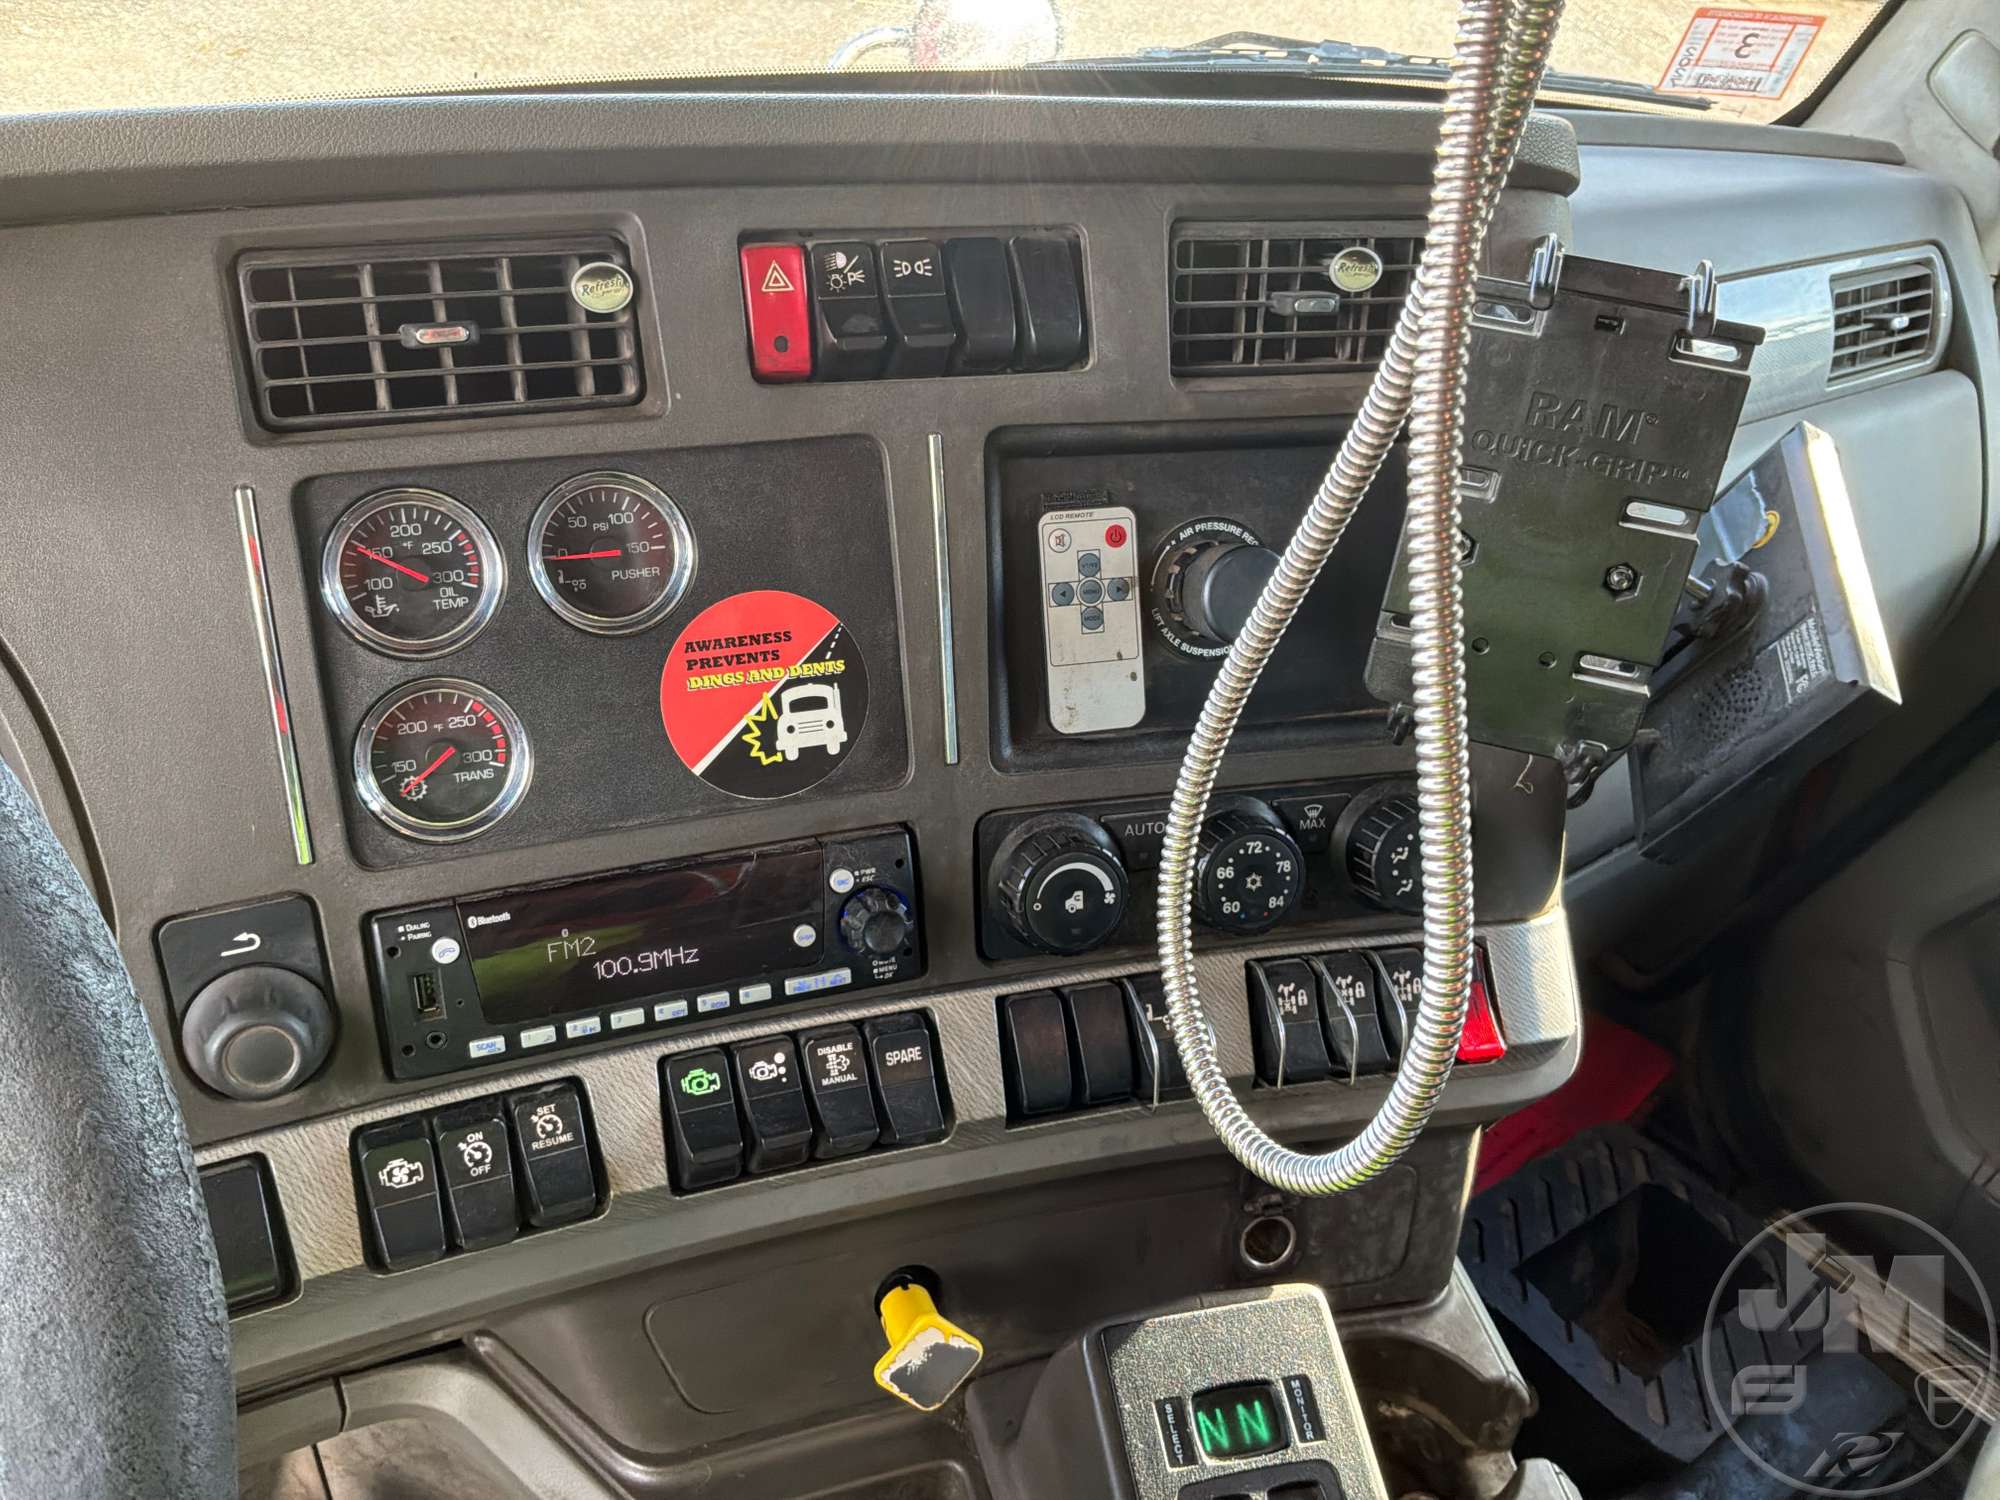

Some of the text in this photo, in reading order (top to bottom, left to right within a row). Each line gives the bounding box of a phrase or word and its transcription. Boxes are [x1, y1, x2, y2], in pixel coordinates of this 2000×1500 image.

[567, 511, 634, 529] 50 100
[592, 522, 609, 532] PSI
[390, 523, 422, 537] 200
[1179, 527, 1194, 541] AIR
[1195, 521, 1243, 537] PRESSURE
[421, 541, 453, 555] 250
[626, 542, 650, 555] 150
[365, 569, 464, 591] 100 300
[611, 566, 661, 581] PUSHER
[439, 587, 459, 598] OIL
[432, 597, 469, 610] TEMP
[1151, 608, 1233, 657] LIFT AXLE SUSPENSIO
[684, 630, 793, 654] AWARENESS
[686, 649, 780, 671] PREVENTS
[687, 660, 846, 691] DINGS AND DENTS
[396, 714, 477, 735] 200 250
[391, 750, 493, 773] 150 300
[453, 768, 495, 783] TRANS
[1124, 821, 1166, 837] AUTO
[1300, 817, 1326, 829] MAX
[1246, 841, 1263, 854] 72
[1217, 860, 1291, 879] 66 78
[1223, 895, 1284, 914] 60 84
[477, 911, 511, 926] Bluetooth
[547, 936, 597, 963] FM2
[593, 946, 700, 980] 100.9MHz
[817, 1042, 853, 1056] DISABLE
[885, 1047, 923, 1066] SPARE
[822, 1073, 858, 1086] MANUAL
[536, 1103, 557, 1116] SET
[467, 1131, 484, 1143] ON
[532, 1132, 575, 1150] RESUME
[470, 1164, 492, 1176] OFF
[1291, 1379, 1315, 1440] MONITOR
[1164, 1403, 1184, 1465] SELECT
